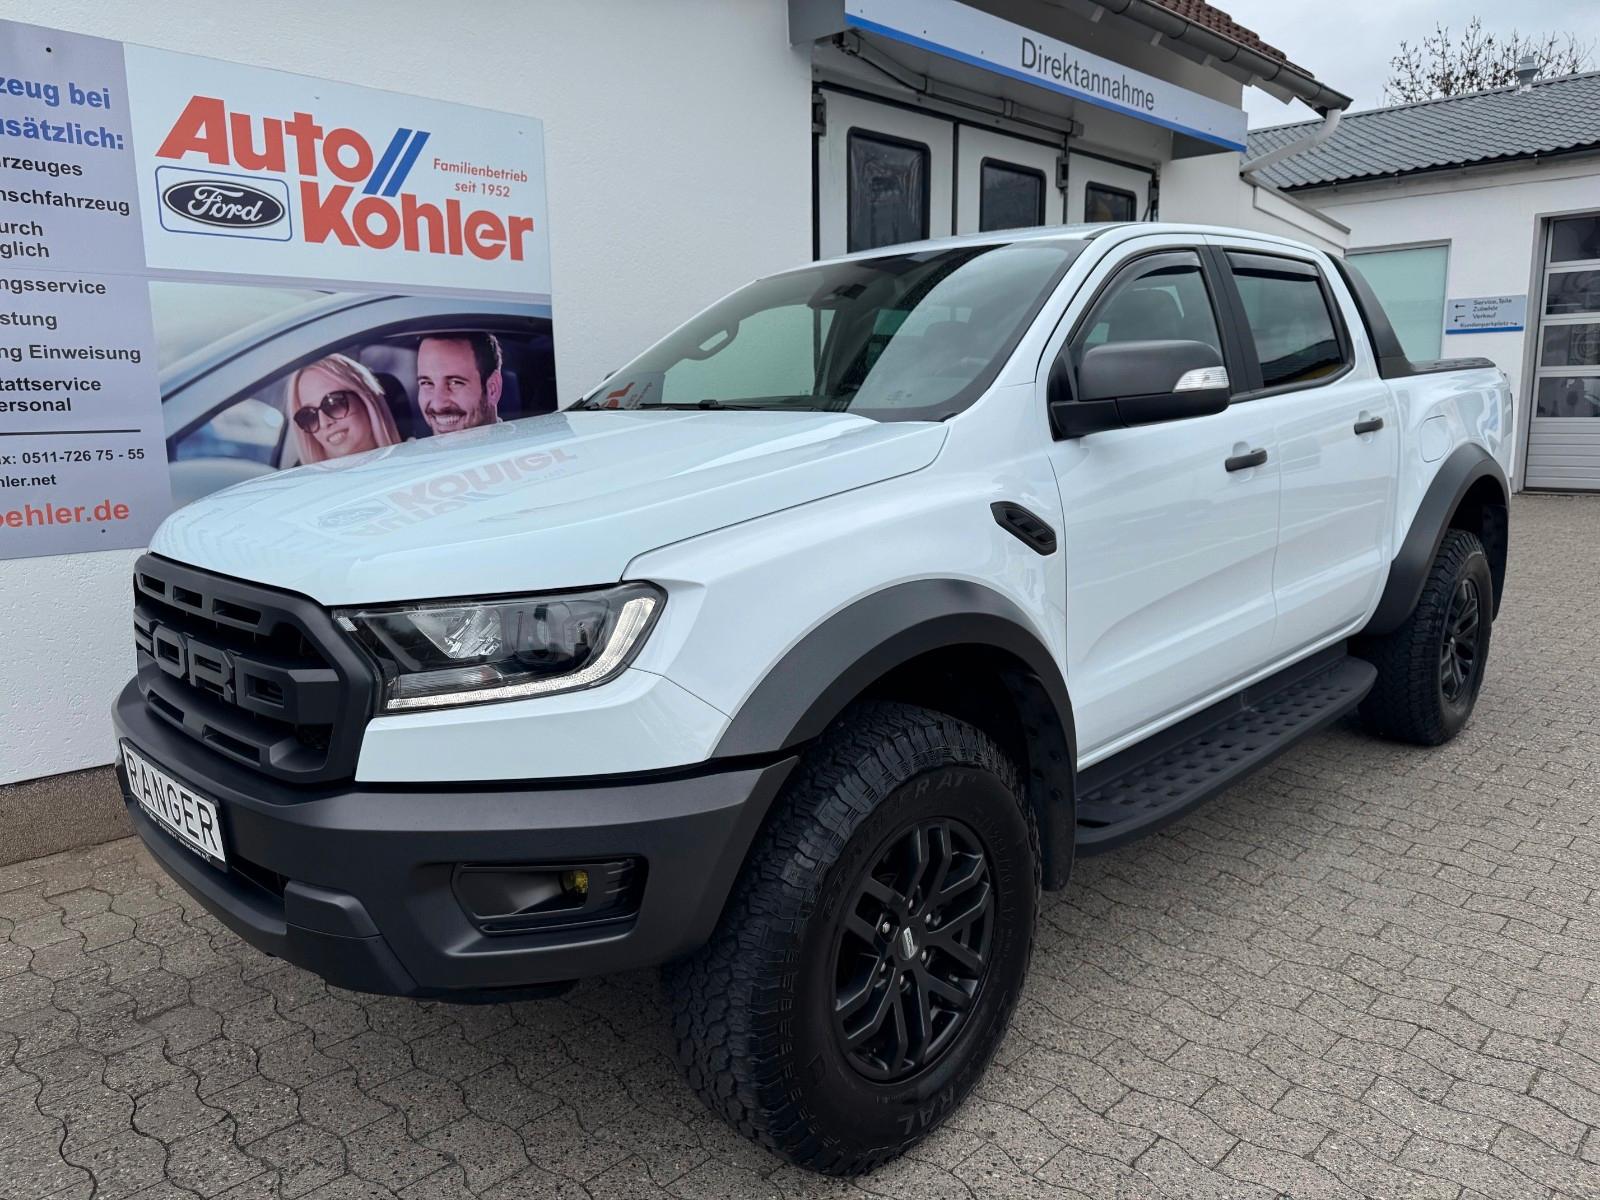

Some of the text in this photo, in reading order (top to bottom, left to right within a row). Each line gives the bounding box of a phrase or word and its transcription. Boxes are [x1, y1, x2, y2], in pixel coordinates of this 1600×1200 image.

[1021, 37, 1154, 111] Direktannahme
[69, 82, 110, 109] bei
[0, 116, 124, 150] sätzlich:
[155, 95, 374, 184] Auto
[0, 156, 83, 177] rzeuges
[433, 157, 529, 183] Familienbetrieb
[455, 180, 511, 198] seit 1952
[186, 186, 263, 222] Ford
[0, 240, 50, 259] glich
[0, 312, 57, 330] stung
[29, 345, 141, 363] Einweisung
[22, 450, 91, 464] 0511-726
[96, 450, 114, 461] 75
[128, 448, 145, 460] 55
[0, 499, 130, 528] ehler.de
[126, 751, 218, 852] RANGER
